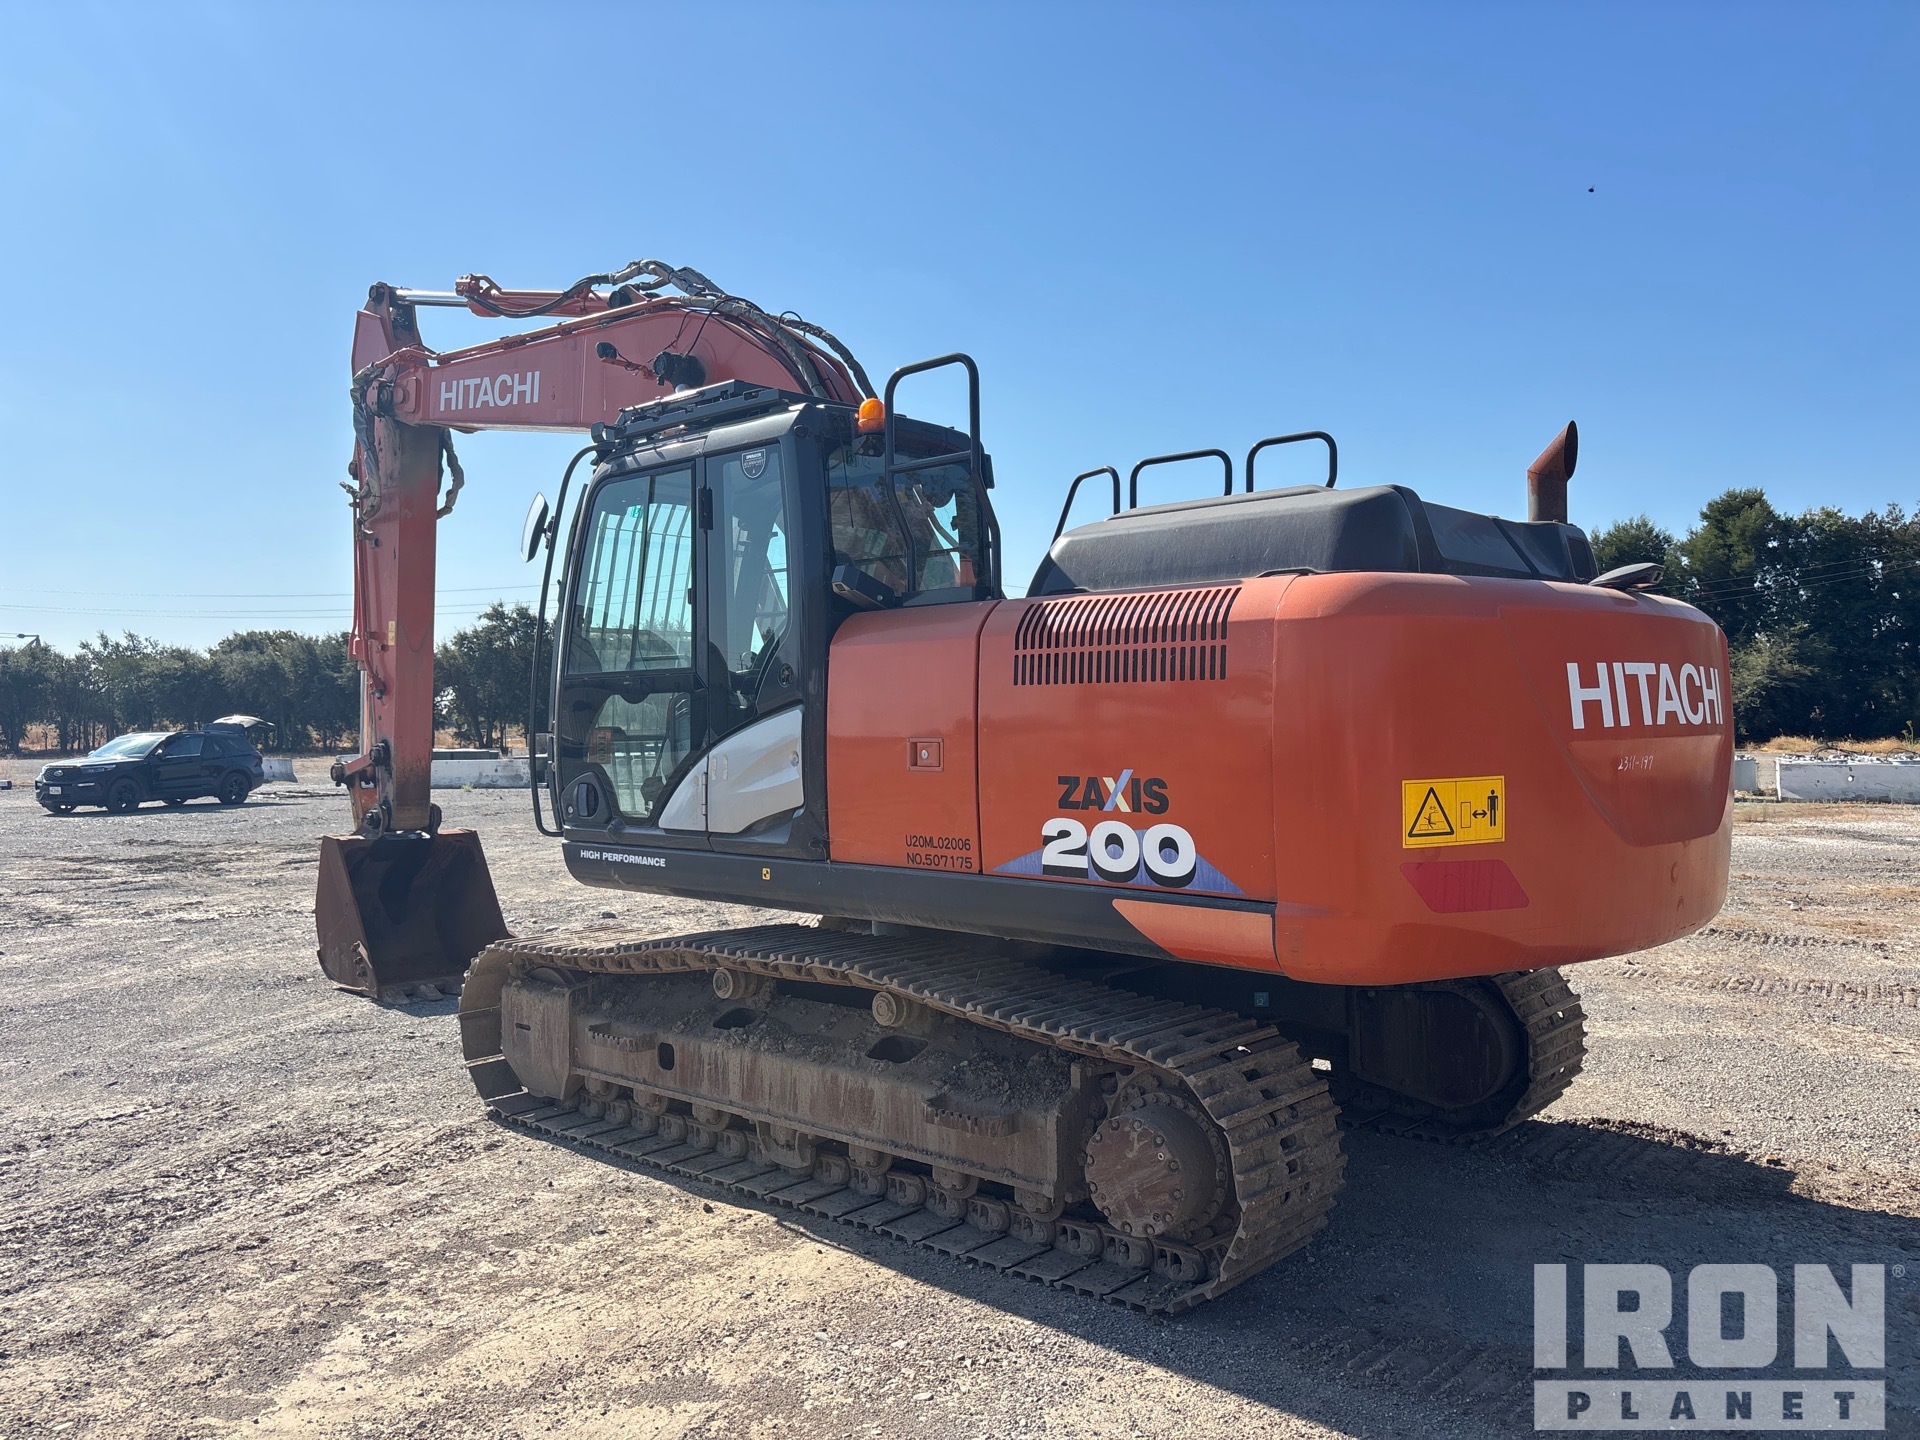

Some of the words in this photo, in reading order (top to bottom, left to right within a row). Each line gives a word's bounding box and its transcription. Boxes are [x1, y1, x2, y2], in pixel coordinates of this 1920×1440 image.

[440, 371, 540, 411] HITACHI
[1566, 662, 1723, 730] HITACHI
[1057, 769, 1169, 814] ZAXIS
[580, 849, 600, 860] HIGH
[602, 852, 666, 867] PERFORMANCE
[905, 834, 971, 851] U20ML02006
[906, 852, 973, 869] NO.507175
[1041, 817, 1197, 888] 200
